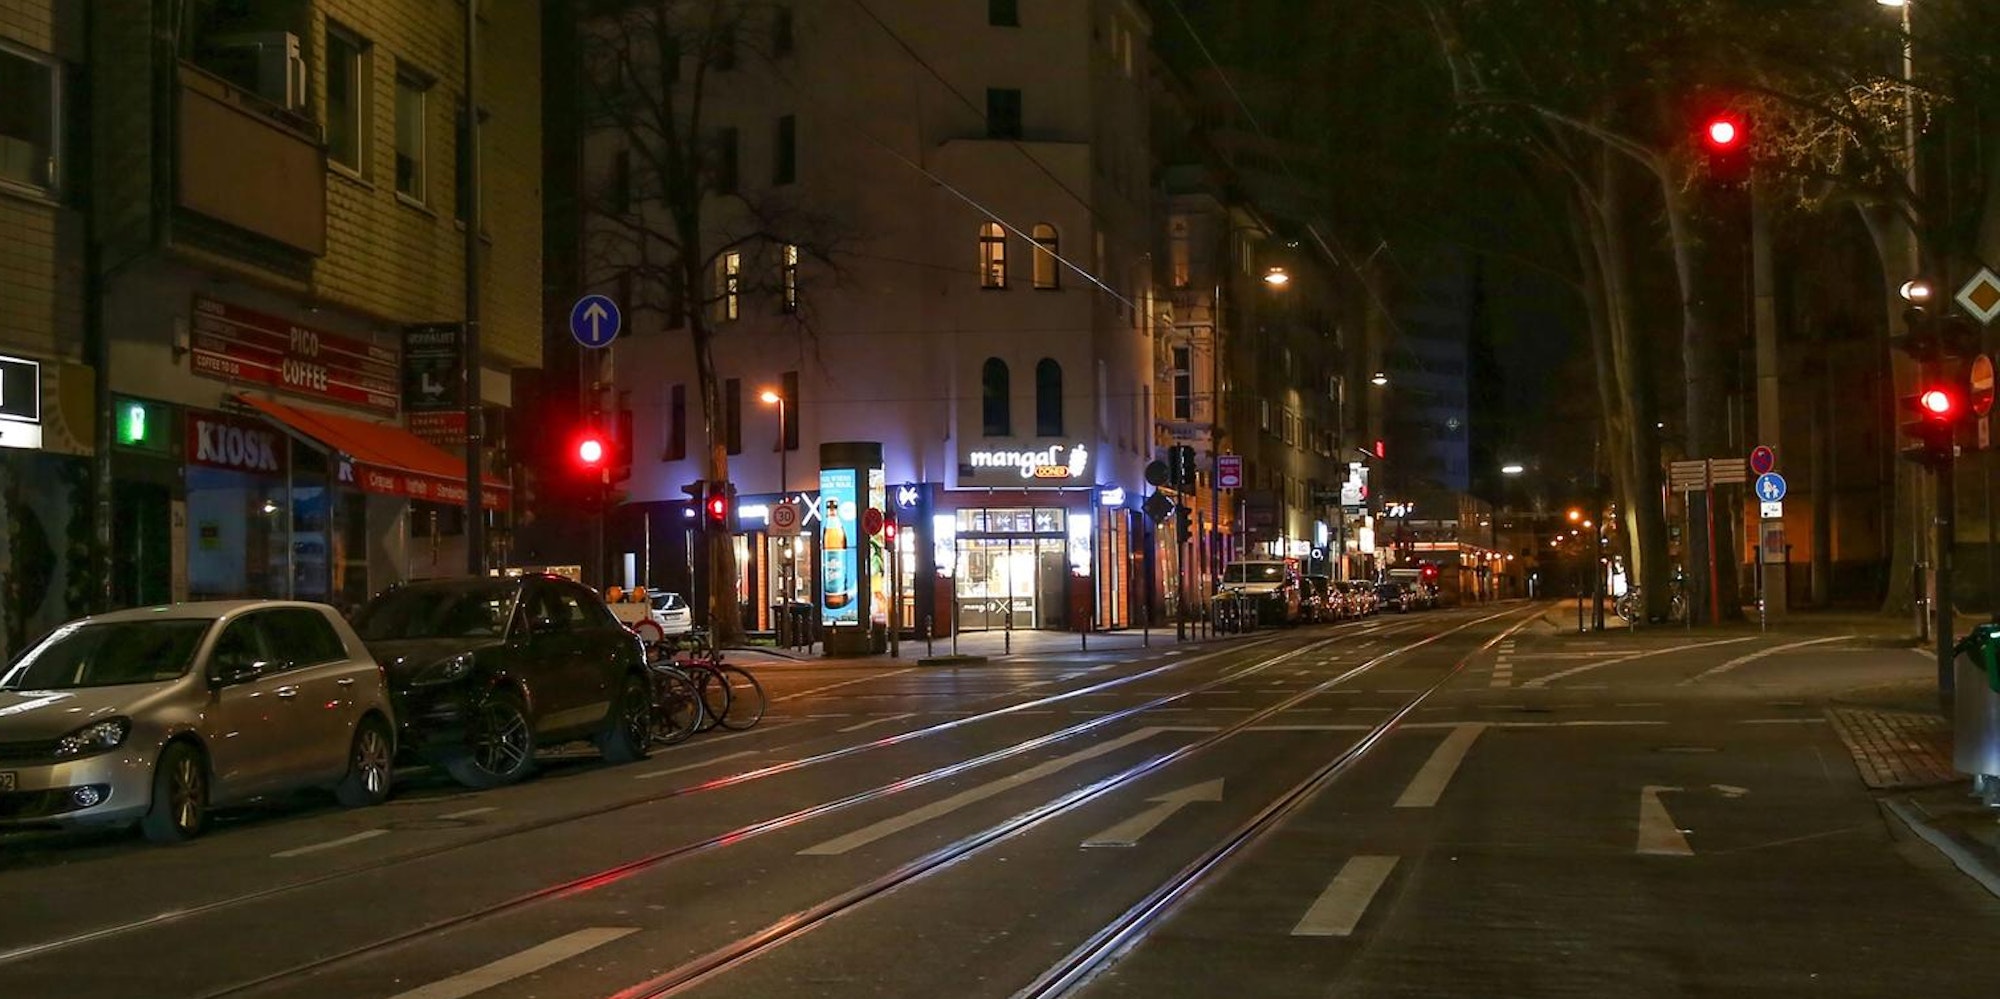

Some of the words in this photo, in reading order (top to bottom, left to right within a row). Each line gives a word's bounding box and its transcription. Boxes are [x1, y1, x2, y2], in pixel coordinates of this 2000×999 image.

[290, 326, 319, 358] PICO
[197, 355, 220, 371] COFFEE
[282, 358, 328, 392] COFFEE
[196, 420, 279, 471] KIOSK
[970, 445, 1064, 478] mangal
[778, 512, 791, 522] 30
